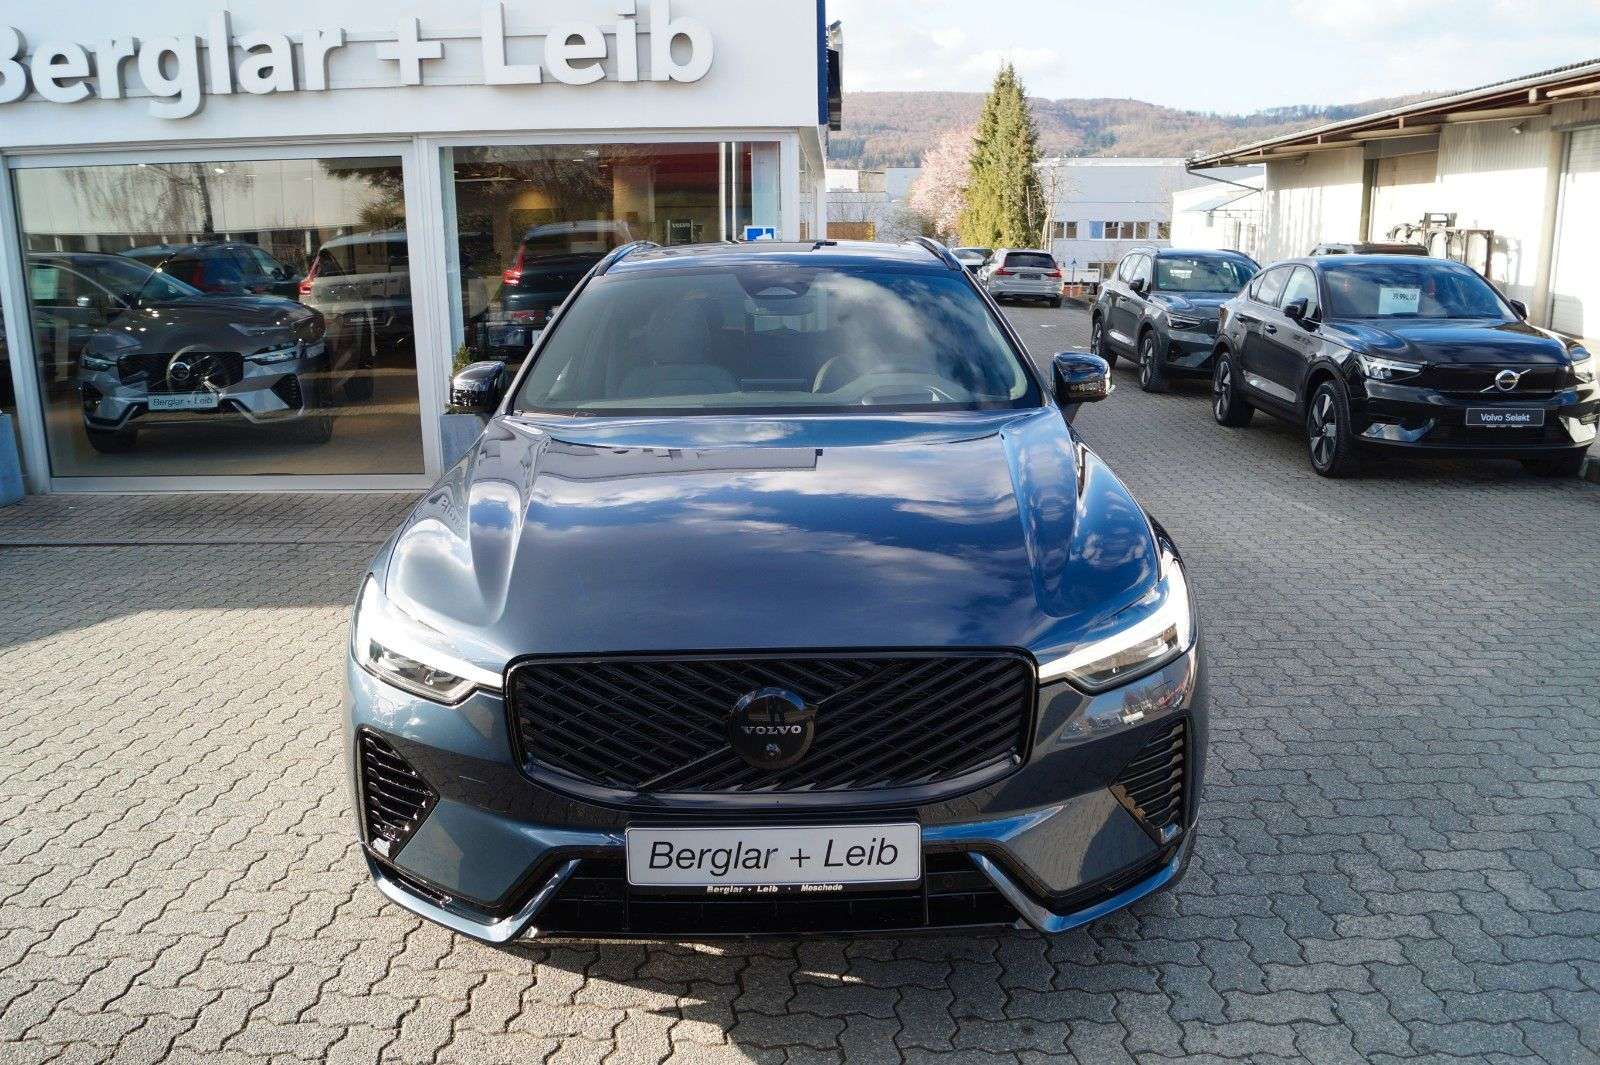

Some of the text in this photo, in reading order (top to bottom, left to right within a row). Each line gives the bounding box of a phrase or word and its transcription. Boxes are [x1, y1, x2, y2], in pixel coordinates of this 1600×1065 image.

[375, 17, 445, 86] +
[481, 0, 714, 85] Leib
[1480, 413, 1530, 421] Volvo Selekt
[741, 725, 802, 735] VOLVO
[648, 837, 898, 877] Berglar + Leib
[706, 884, 744, 894] Berglar
[756, 885, 779, 893] Leib
